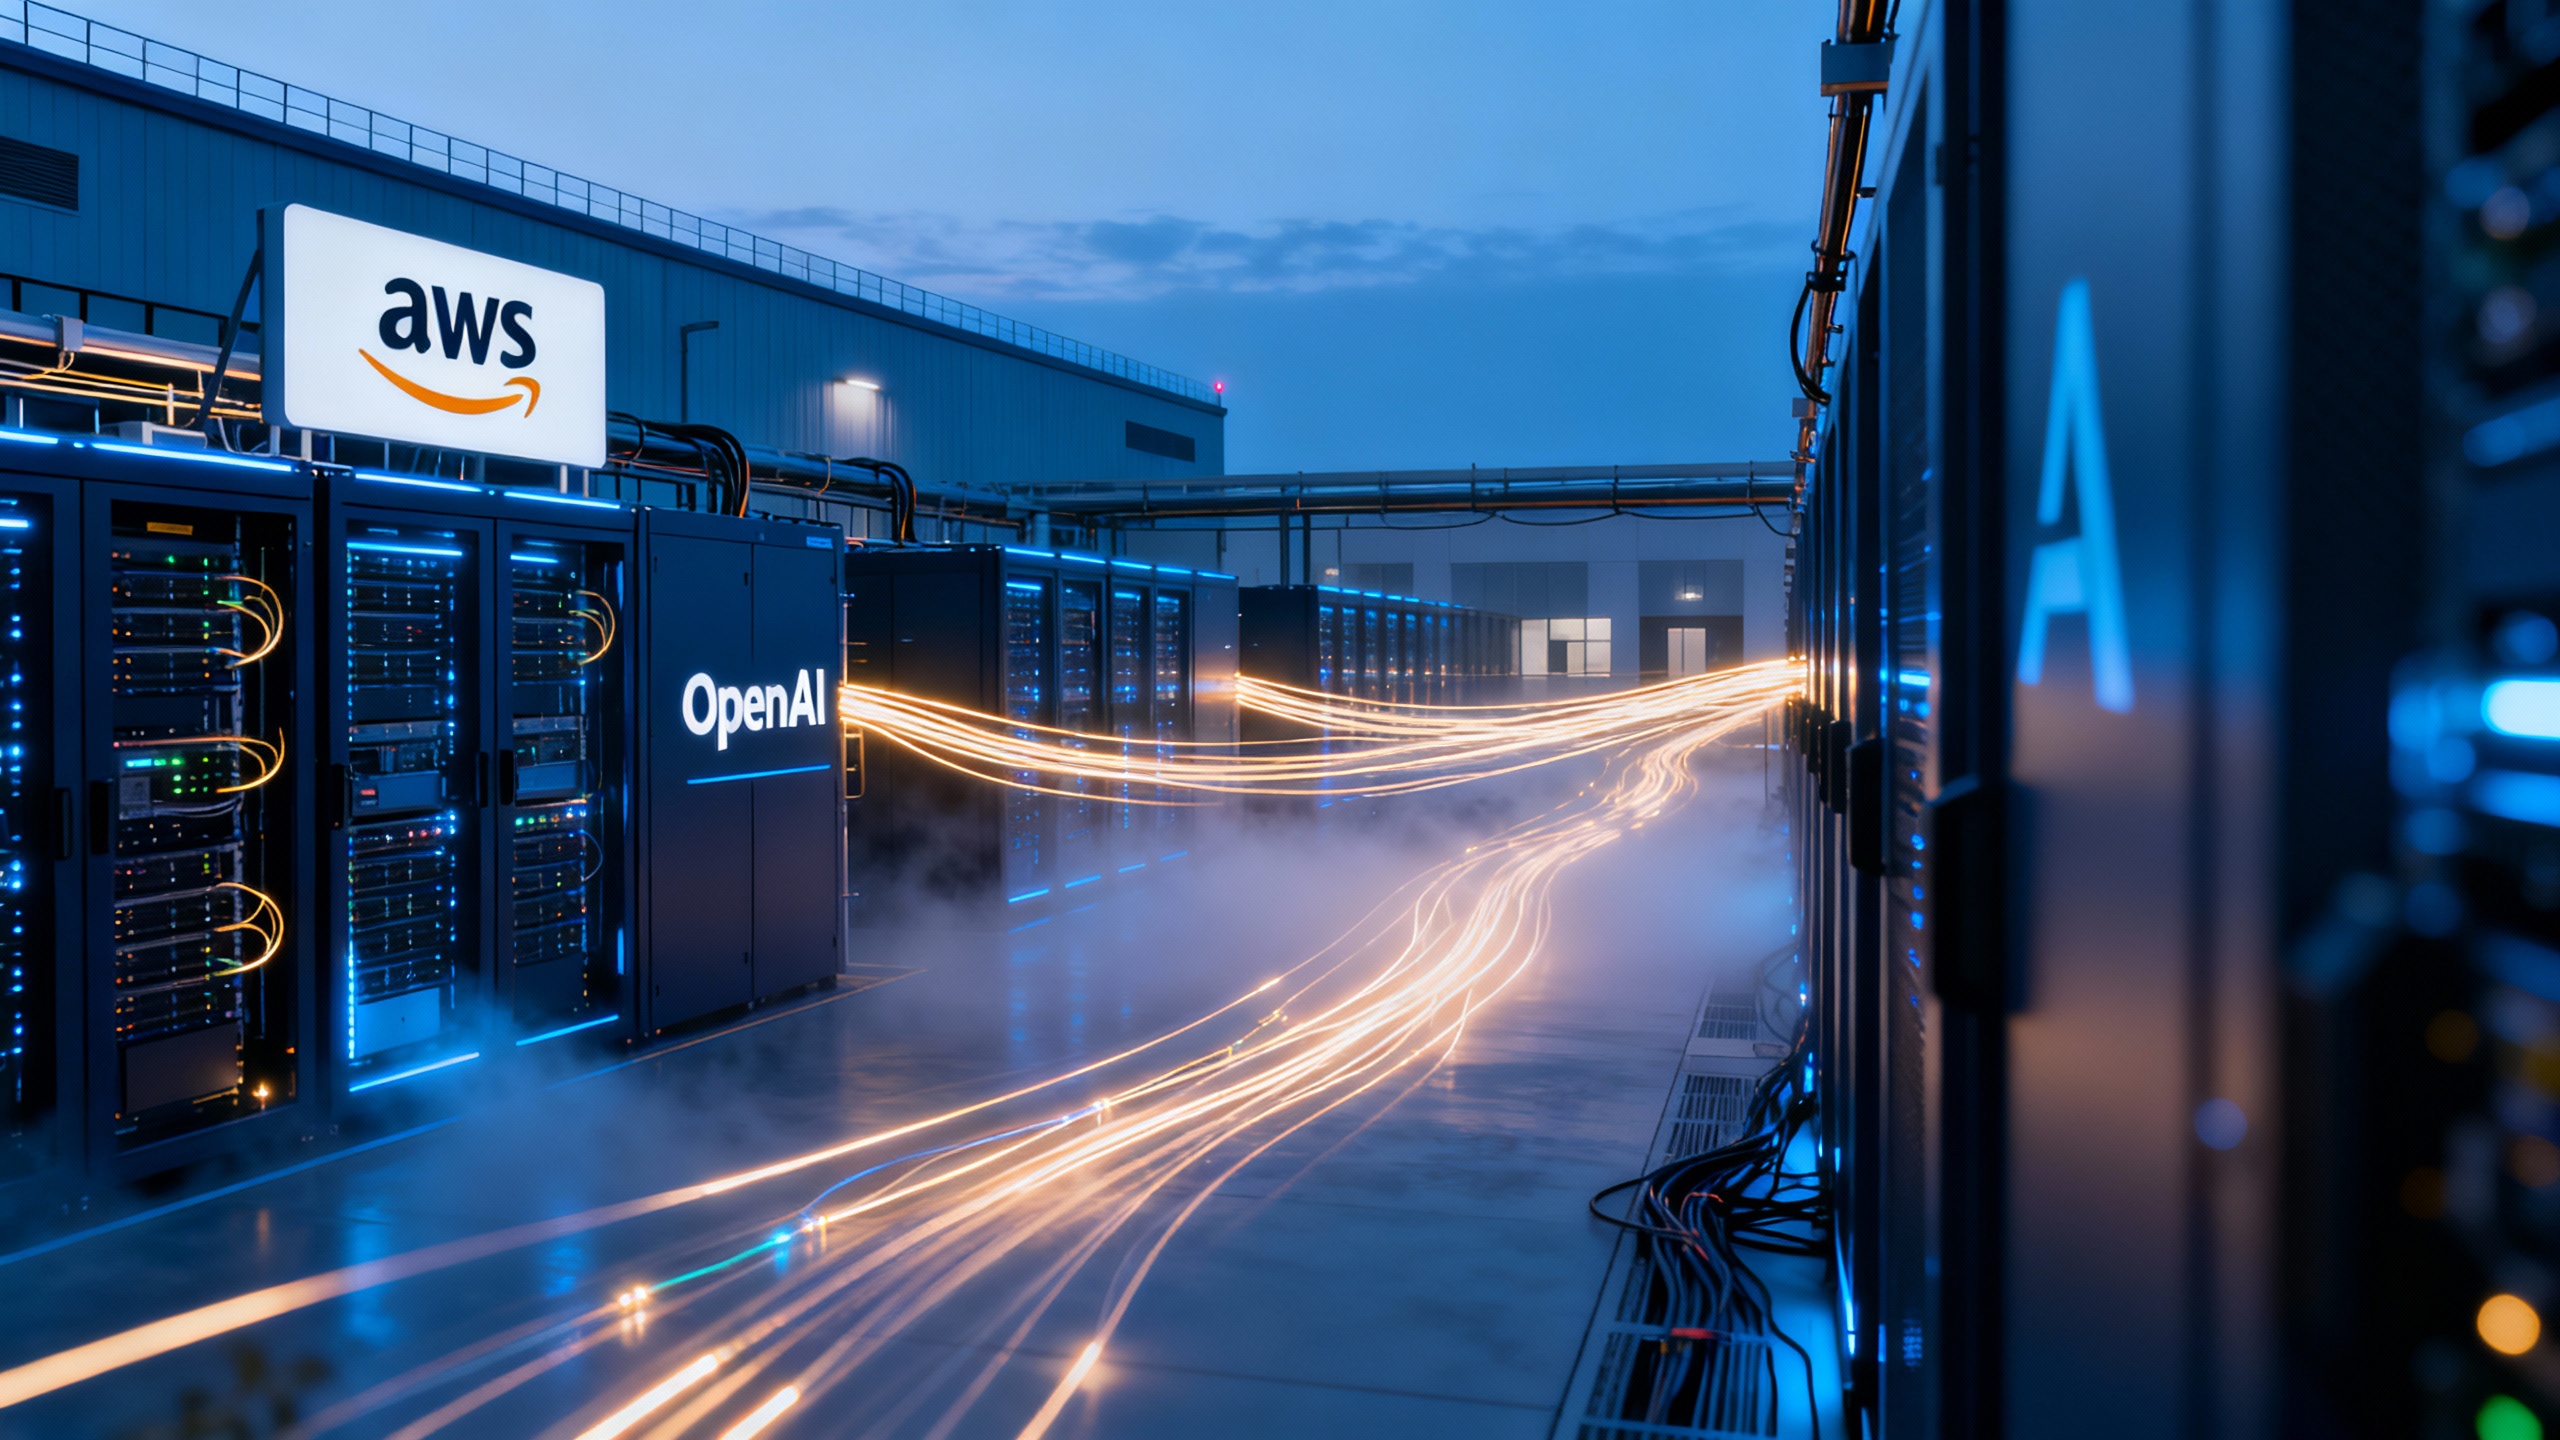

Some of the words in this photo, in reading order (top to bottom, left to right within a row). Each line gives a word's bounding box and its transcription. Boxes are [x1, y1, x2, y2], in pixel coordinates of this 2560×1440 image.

[378, 277, 537, 369] aws
[2017, 278, 2135, 713] A
[682, 668, 826, 751] OpenAI
